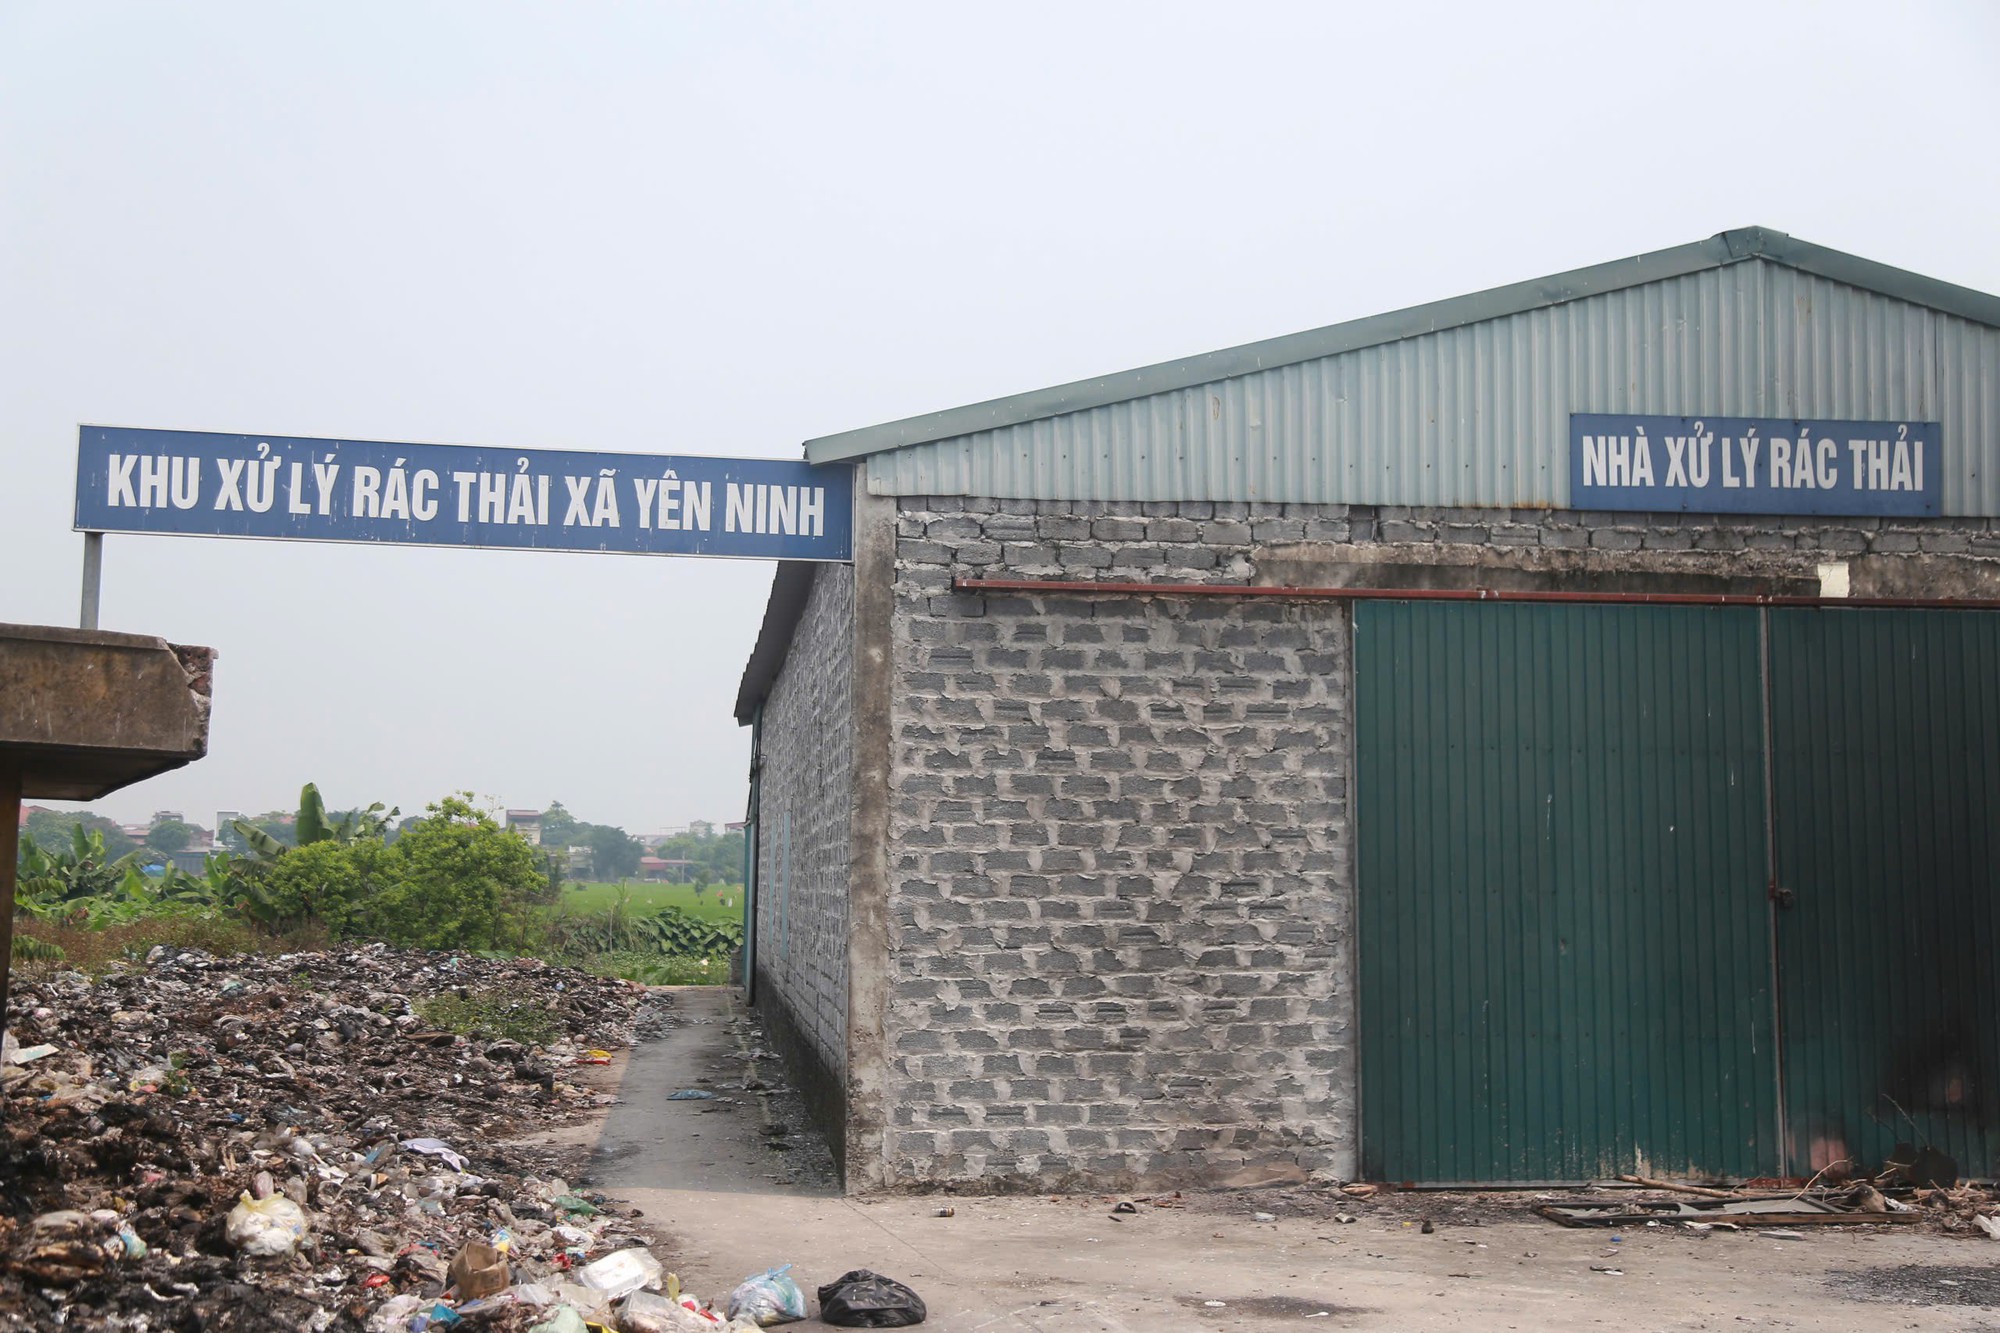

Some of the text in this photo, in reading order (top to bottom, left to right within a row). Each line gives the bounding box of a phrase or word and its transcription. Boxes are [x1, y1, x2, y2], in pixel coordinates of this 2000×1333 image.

[107, 442, 825, 537] KHU XỬ LÝ RÁC THẢI XÃ YÊN NINH
[1582, 421, 1924, 492] NHÀ XỬ LÝ RÁC THẢI
